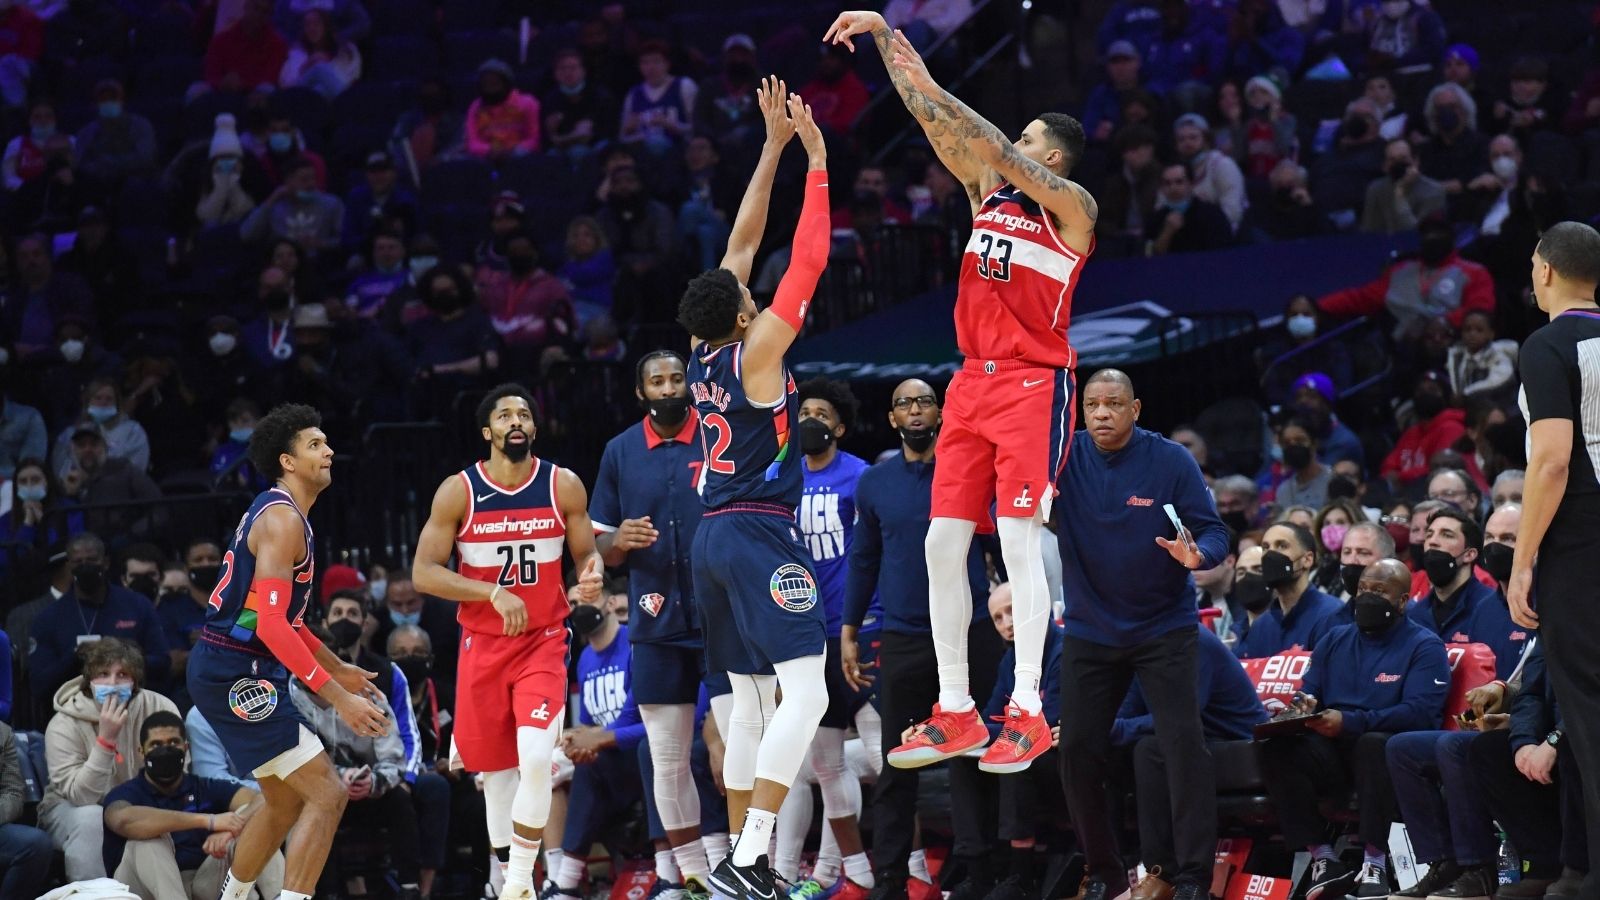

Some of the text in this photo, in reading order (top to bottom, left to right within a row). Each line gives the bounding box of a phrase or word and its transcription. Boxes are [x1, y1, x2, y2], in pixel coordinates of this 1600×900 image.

[977, 233, 1013, 283] 33
[1013, 488, 1033, 508] dc
[798, 493, 844, 534] ACK
[472, 515, 555, 536] washington
[496, 543, 539, 588] 26
[1260, 655, 1311, 680] BIO
[584, 670, 627, 715] BLACK
[1256, 681, 1296, 695] STEEL
[530, 702, 550, 721] dc
[1246, 874, 1275, 896] BIO
